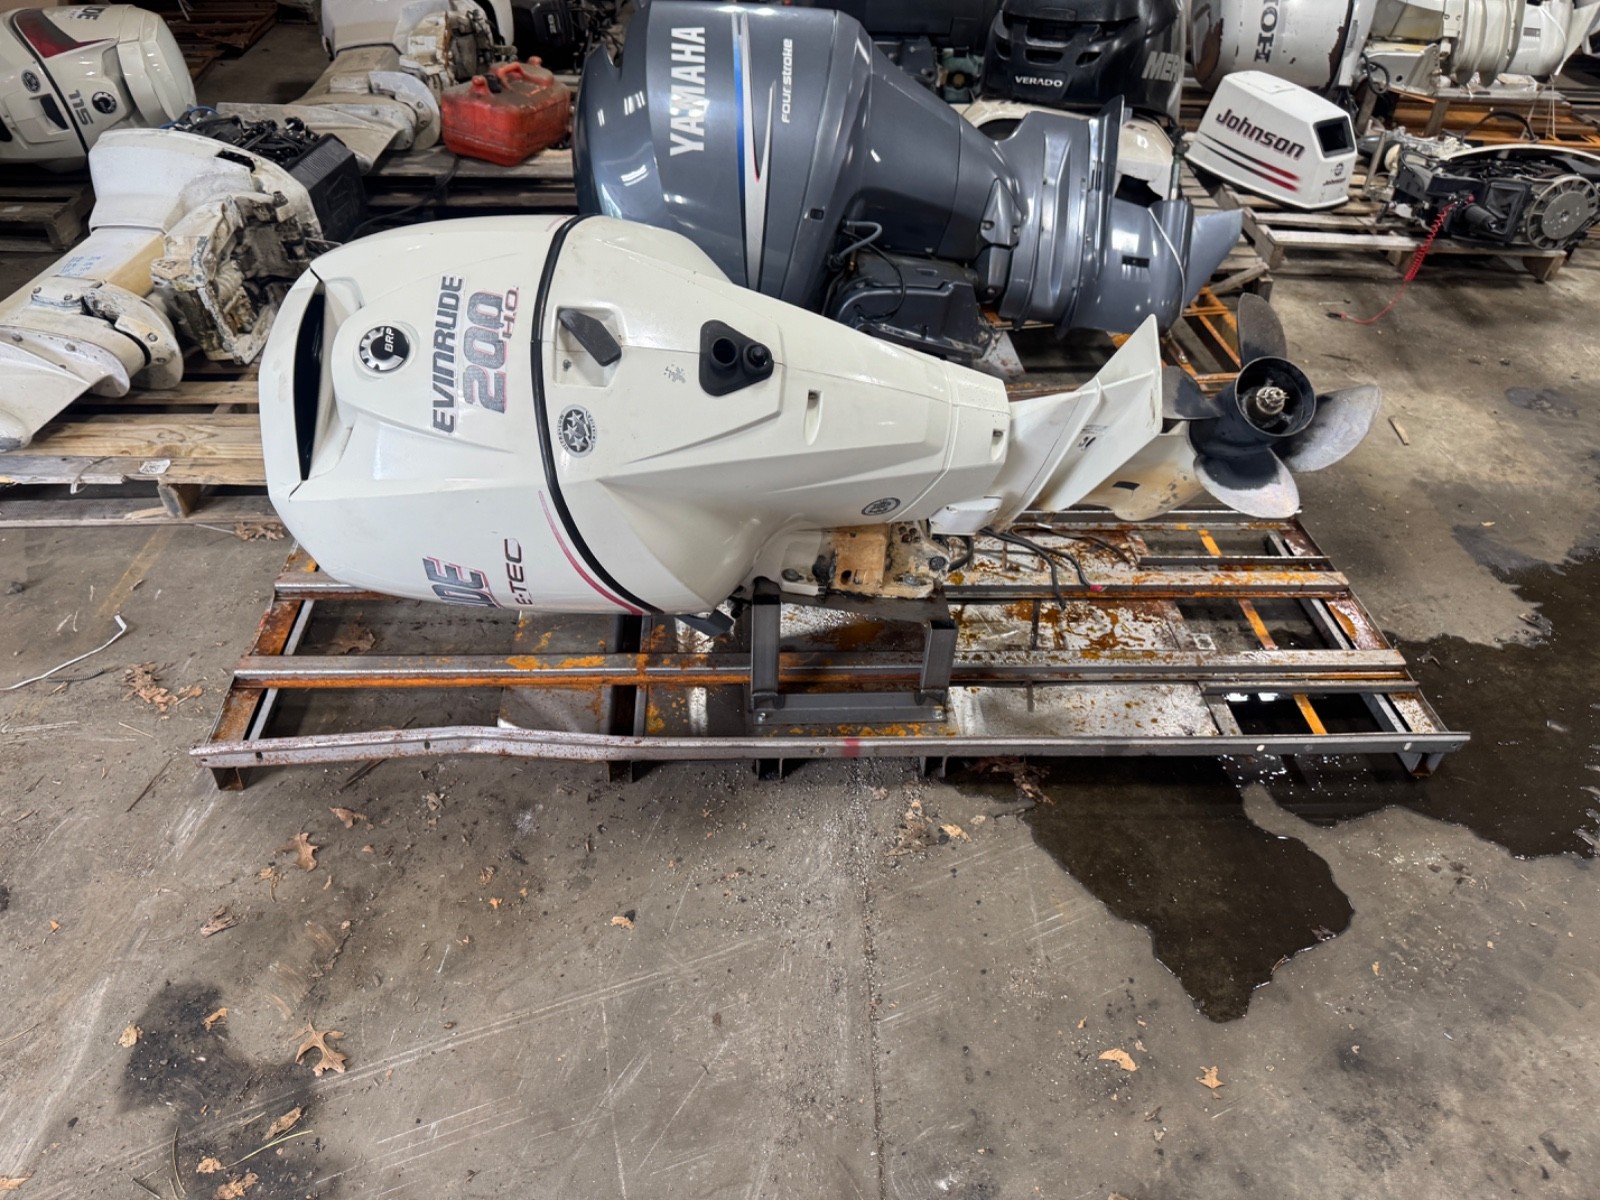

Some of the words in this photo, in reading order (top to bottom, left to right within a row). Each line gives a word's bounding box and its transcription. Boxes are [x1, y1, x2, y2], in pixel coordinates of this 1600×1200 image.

[1254, 0, 1279, 63] HO
[68, 89, 94, 125] 115
[669, 27, 706, 157] YAMAHA
[1014, 75, 1063, 88] VERADO
[1215, 108, 1306, 160] Johnson
[384, 326, 396, 353] BRP
[432, 275, 463, 434] EVINRUDE
[462, 289, 508, 414] 200
